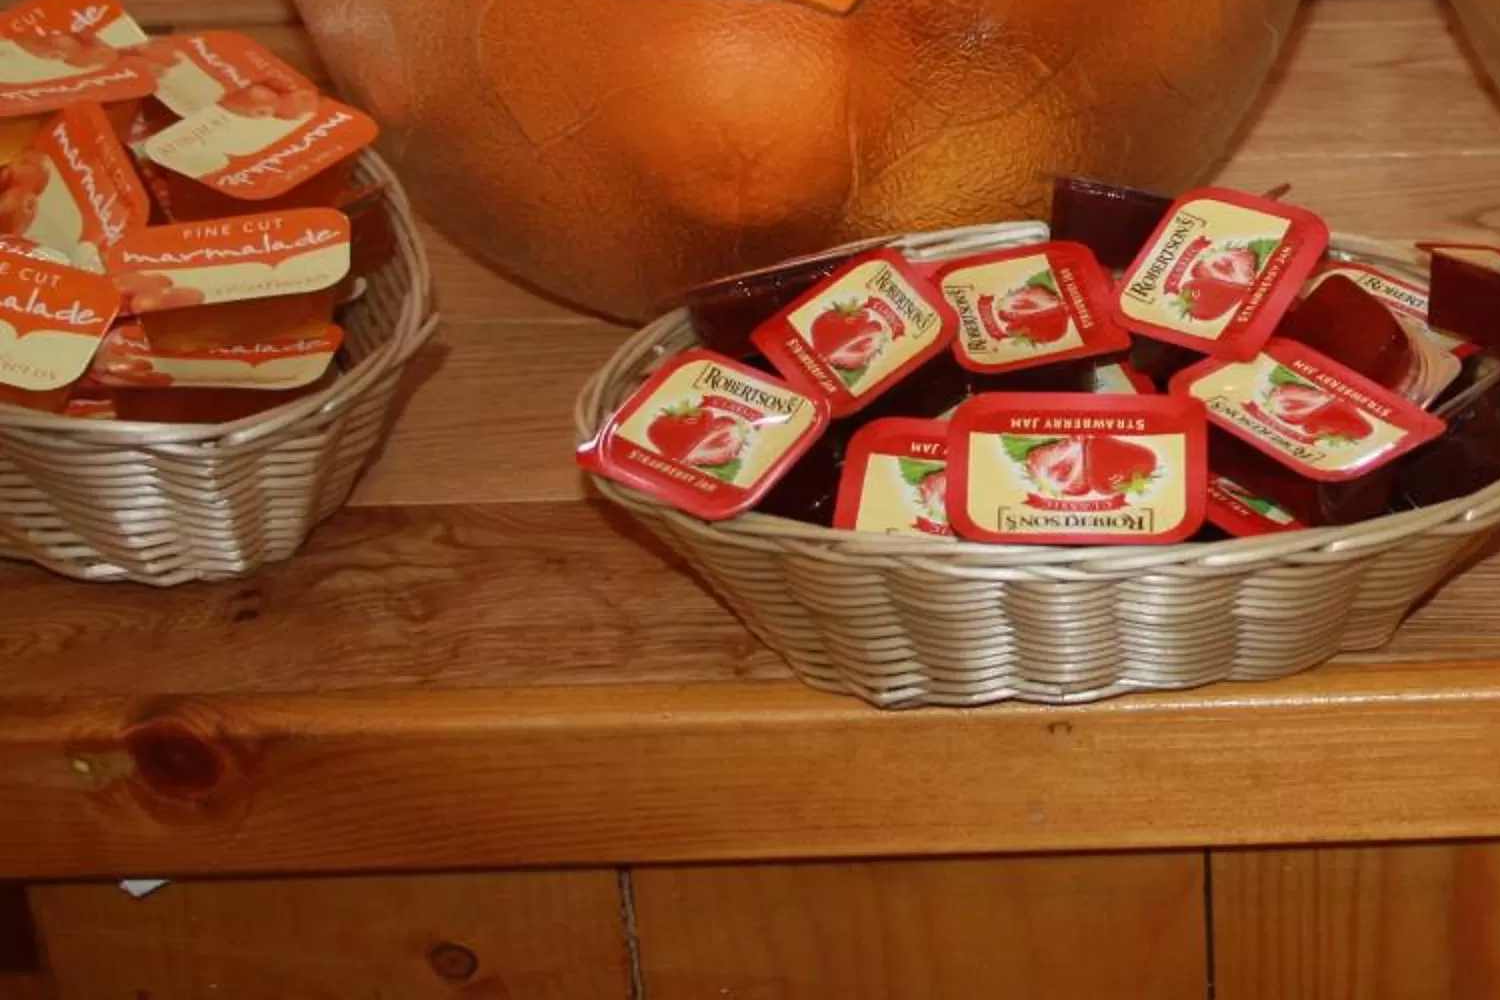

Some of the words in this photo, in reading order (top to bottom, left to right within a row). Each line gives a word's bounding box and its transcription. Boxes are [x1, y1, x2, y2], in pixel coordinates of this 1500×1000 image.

[243, 217, 285, 233] CUT
[122, 229, 341, 263] marmalade
[19, 267, 62, 288] CUT
[1366, 277, 1425, 308] ROBERT
[704, 365, 798, 414] ROBERTSON'S
[1010, 417, 1041, 429] JAM
[1043, 417, 1146, 430] STRAWBERRY
[1004, 510, 1146, 532] ROBERTSON'S
